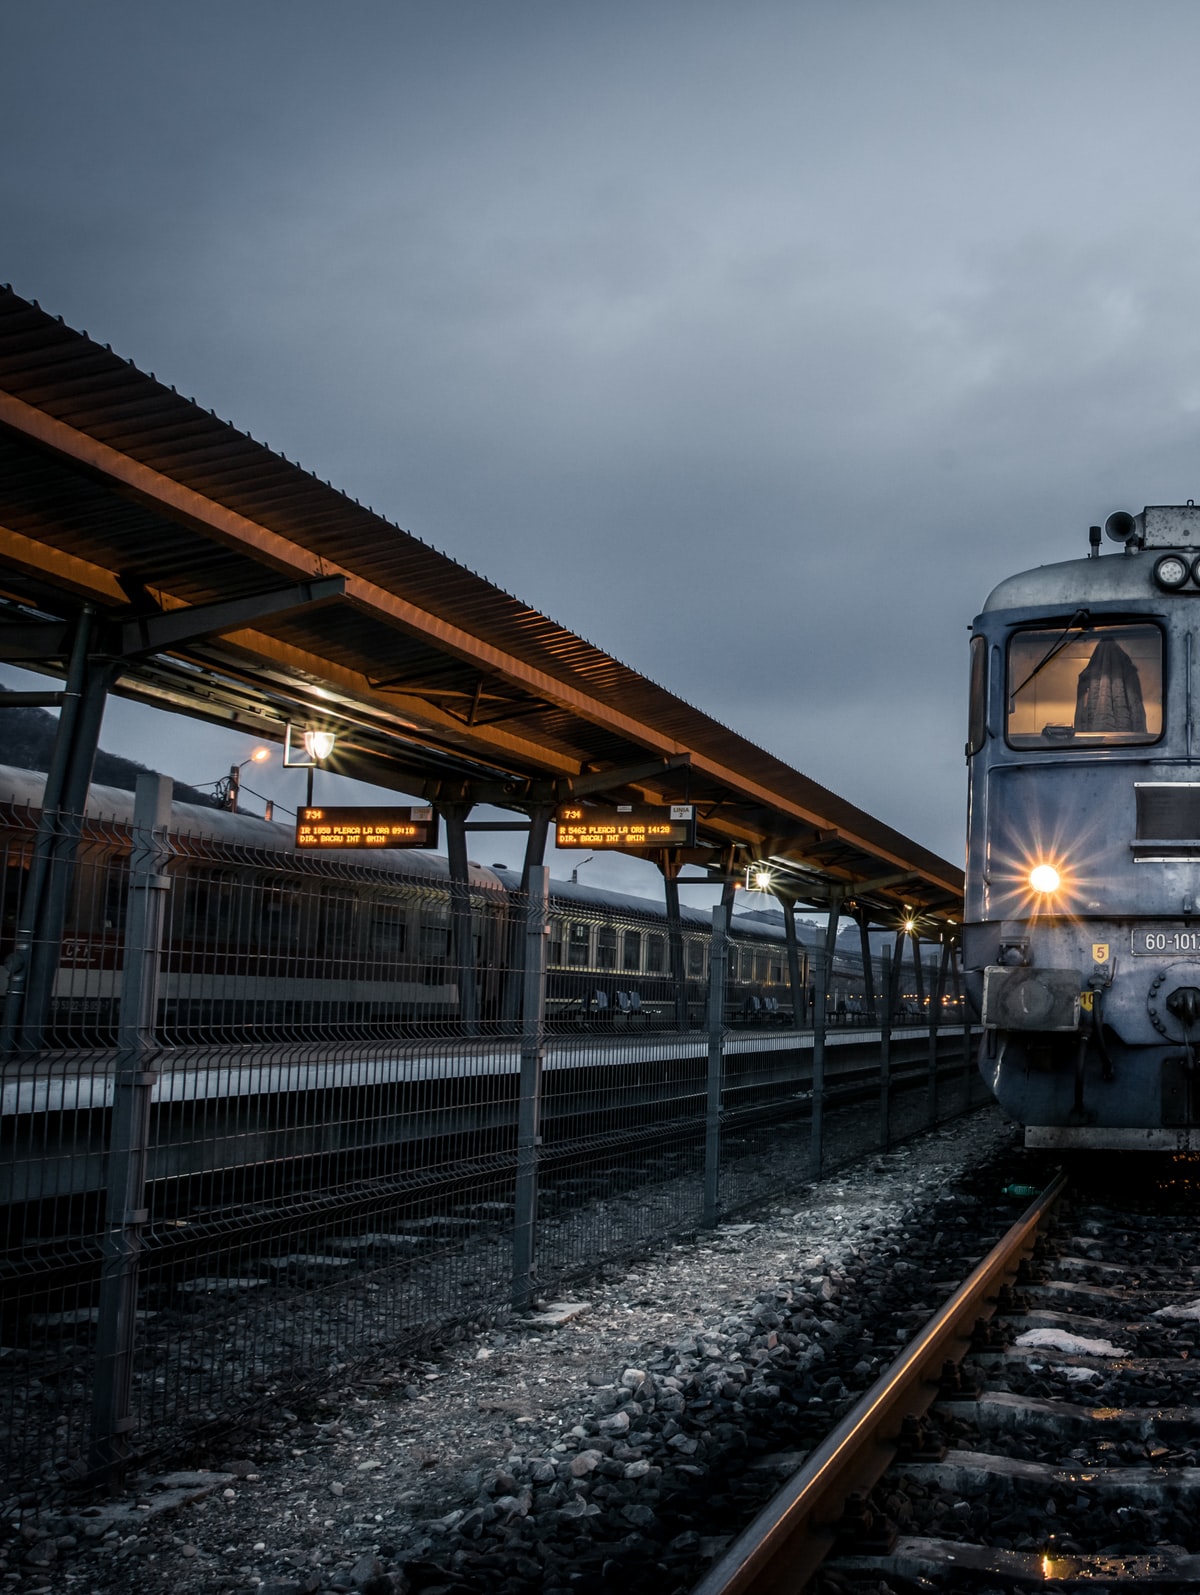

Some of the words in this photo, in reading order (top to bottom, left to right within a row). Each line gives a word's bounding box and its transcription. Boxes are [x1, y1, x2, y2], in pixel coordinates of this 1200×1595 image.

[333, 826, 361, 834] PLEACA
[362, 826, 373, 834] LA
[375, 826, 390, 834] ORA
[559, 826, 566, 834] R
[589, 826, 616, 834] PLEACA
[617, 826, 628, 834] LA
[630, 826, 645, 834] ORA
[299, 834, 317, 843] DIR.
[320, 835, 344, 843] BACAU
[346, 835, 360, 843] INT
[559, 834, 577, 842] DIR.
[580, 834, 603, 842] BACAU
[606, 834, 620, 842] INT
[1096, 946, 1105, 958] 5
[1080, 993, 1094, 1005] 10
